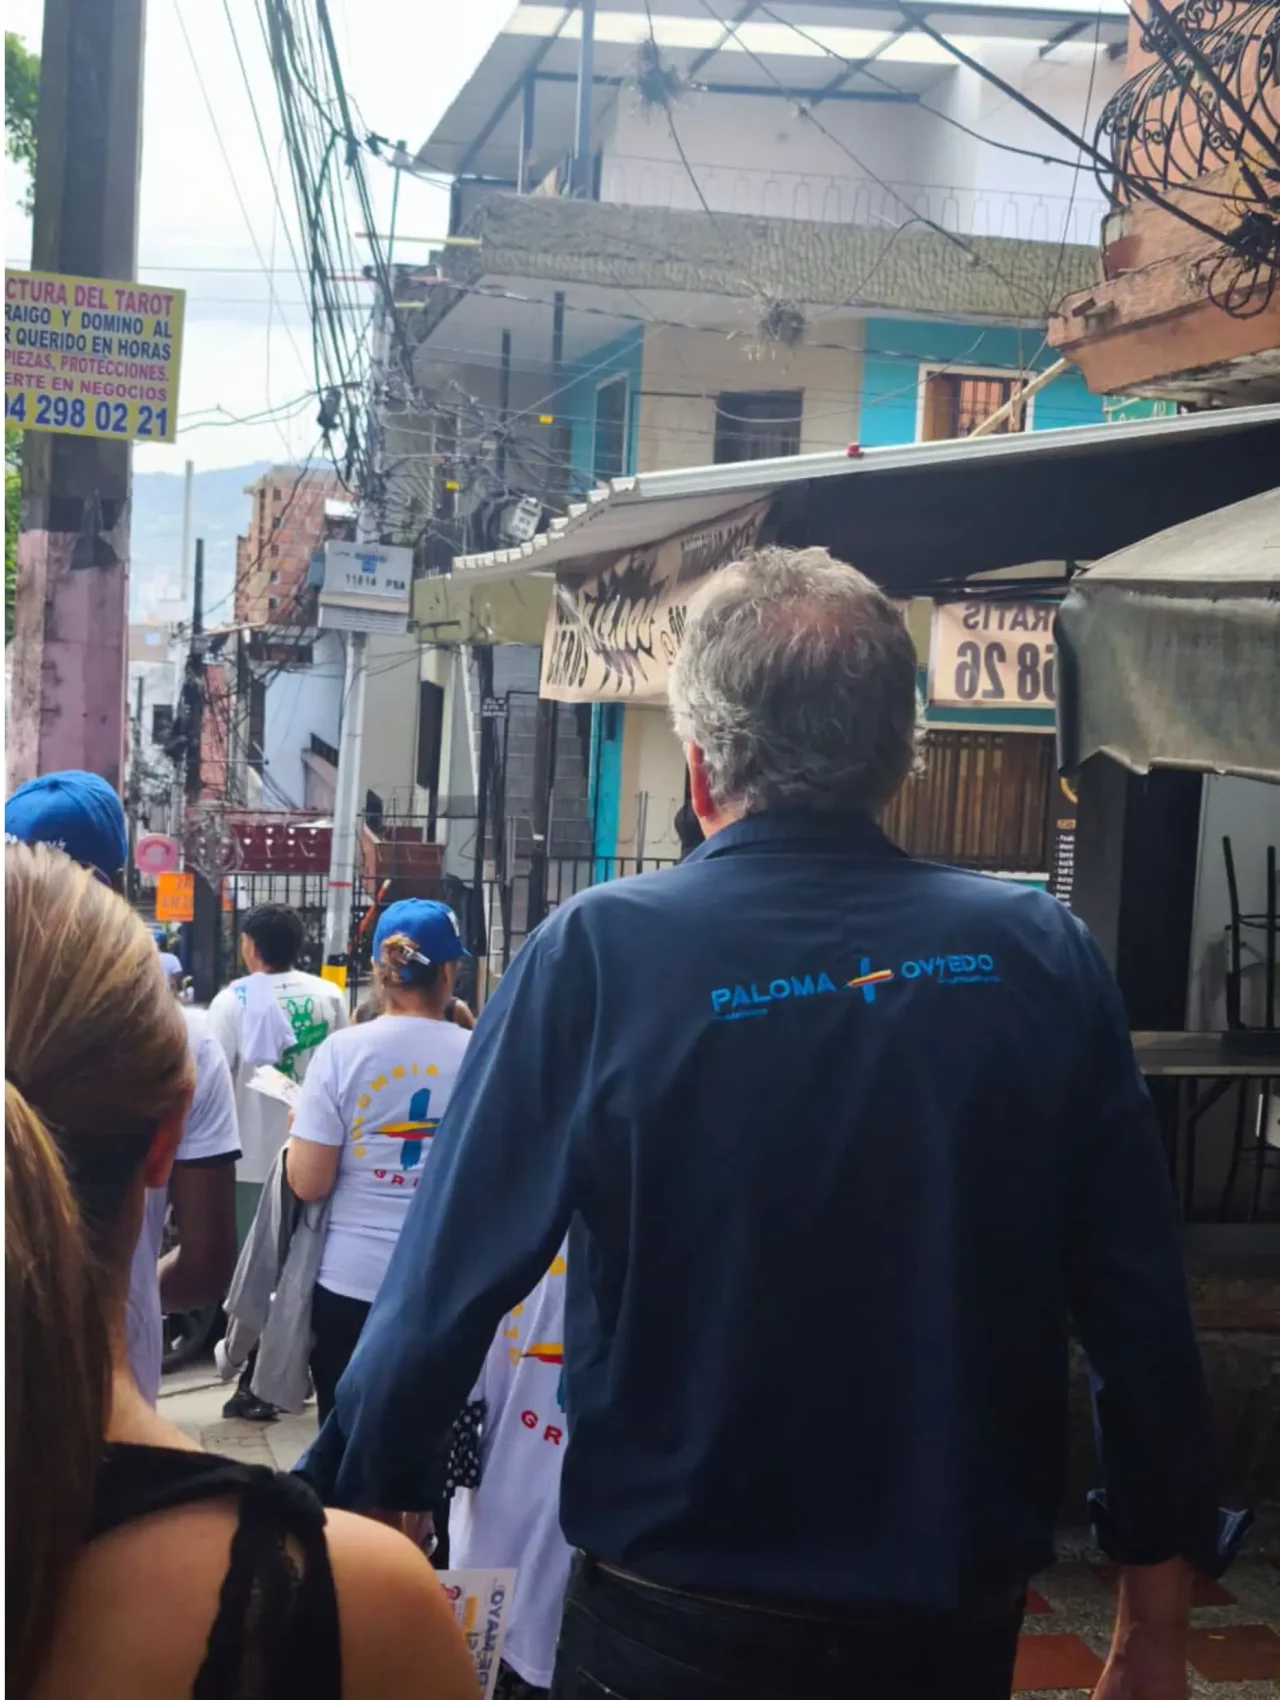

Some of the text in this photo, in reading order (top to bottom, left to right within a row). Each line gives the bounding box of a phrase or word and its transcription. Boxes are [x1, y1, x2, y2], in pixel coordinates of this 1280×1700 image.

[5, 277, 174, 317] CTURA DEL TAROT
[62, 310, 72, 327] Y
[81, 313, 144, 335] DOMINO
[153, 320, 172, 338] AL
[16, 328, 86, 351] QUERIDO
[92, 336, 112, 355] EN
[118, 339, 171, 361] HORAS
[60, 355, 170, 382] PROTECCIONES.
[52, 376, 73, 393] EN
[80, 380, 168, 402] NEGOCIOS
[36, 394, 86, 429] 298
[96, 401, 128, 433] 02
[138, 405, 168, 437] 21
[710, 953, 993, 1012] PALOMA OVIEDO
